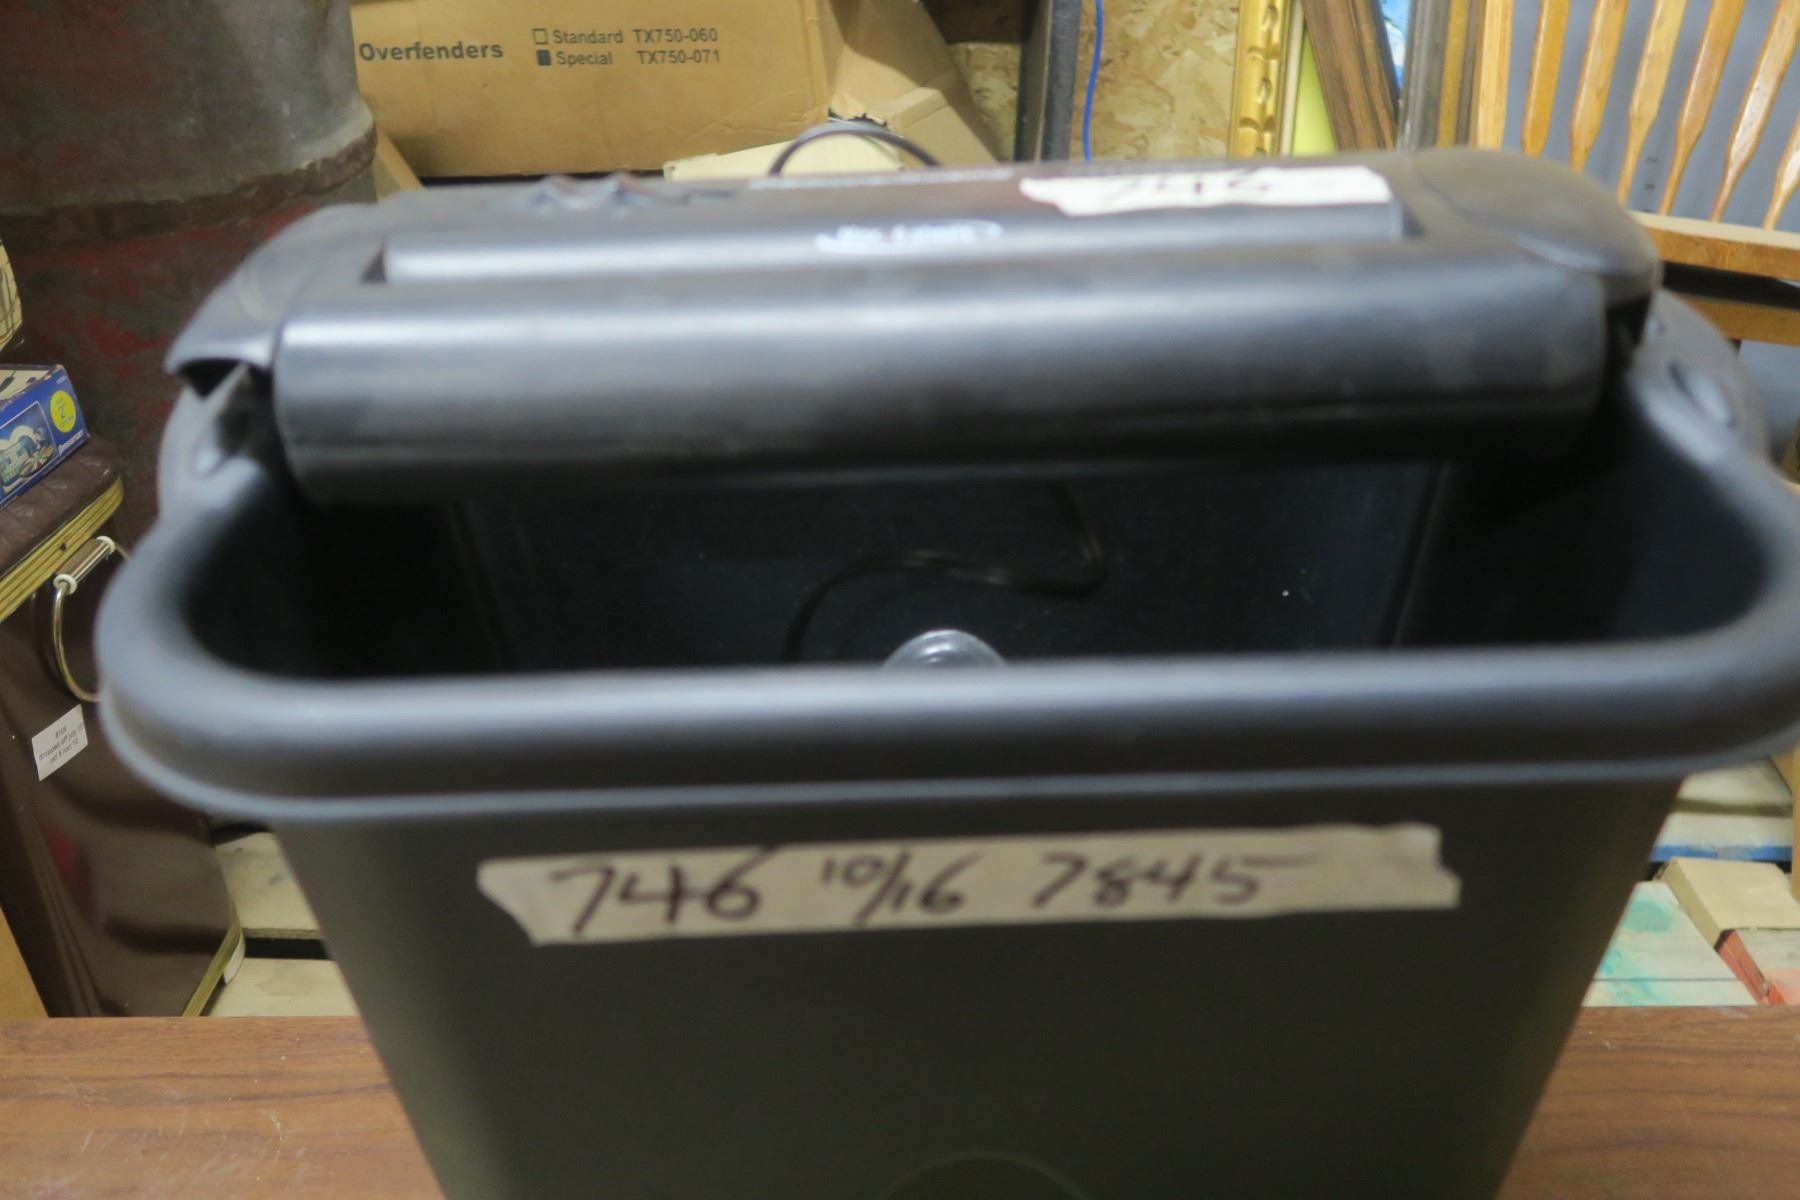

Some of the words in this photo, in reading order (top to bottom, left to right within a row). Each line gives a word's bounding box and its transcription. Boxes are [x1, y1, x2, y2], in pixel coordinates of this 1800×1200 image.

[553, 28, 624, 44] Standard
[632, 28, 718, 43] TX750-060
[359, 41, 504, 61] Overfenders
[556, 50, 613, 67] Special
[636, 49, 720, 65] TX750-071
[549, 845, 780, 935] 746
[820, 851, 986, 927] 10/16
[1030, 851, 1322, 909] 7845
